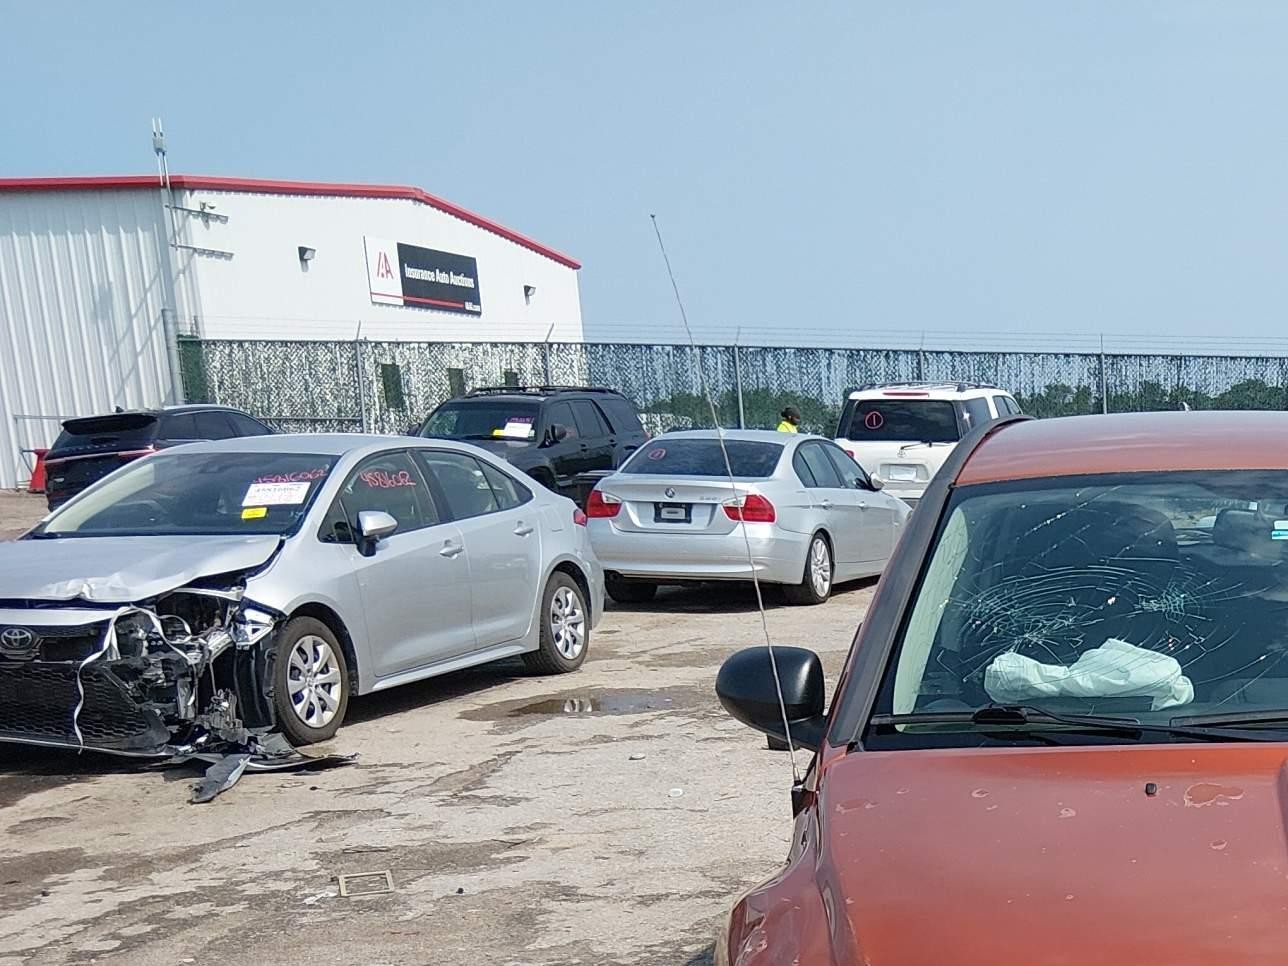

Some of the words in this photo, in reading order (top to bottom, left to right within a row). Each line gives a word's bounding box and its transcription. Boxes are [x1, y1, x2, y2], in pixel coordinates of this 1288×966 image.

[404, 263, 435, 282] Insurance
[435, 268, 450, 284] Auto
[450, 271, 475, 289] Auctions
